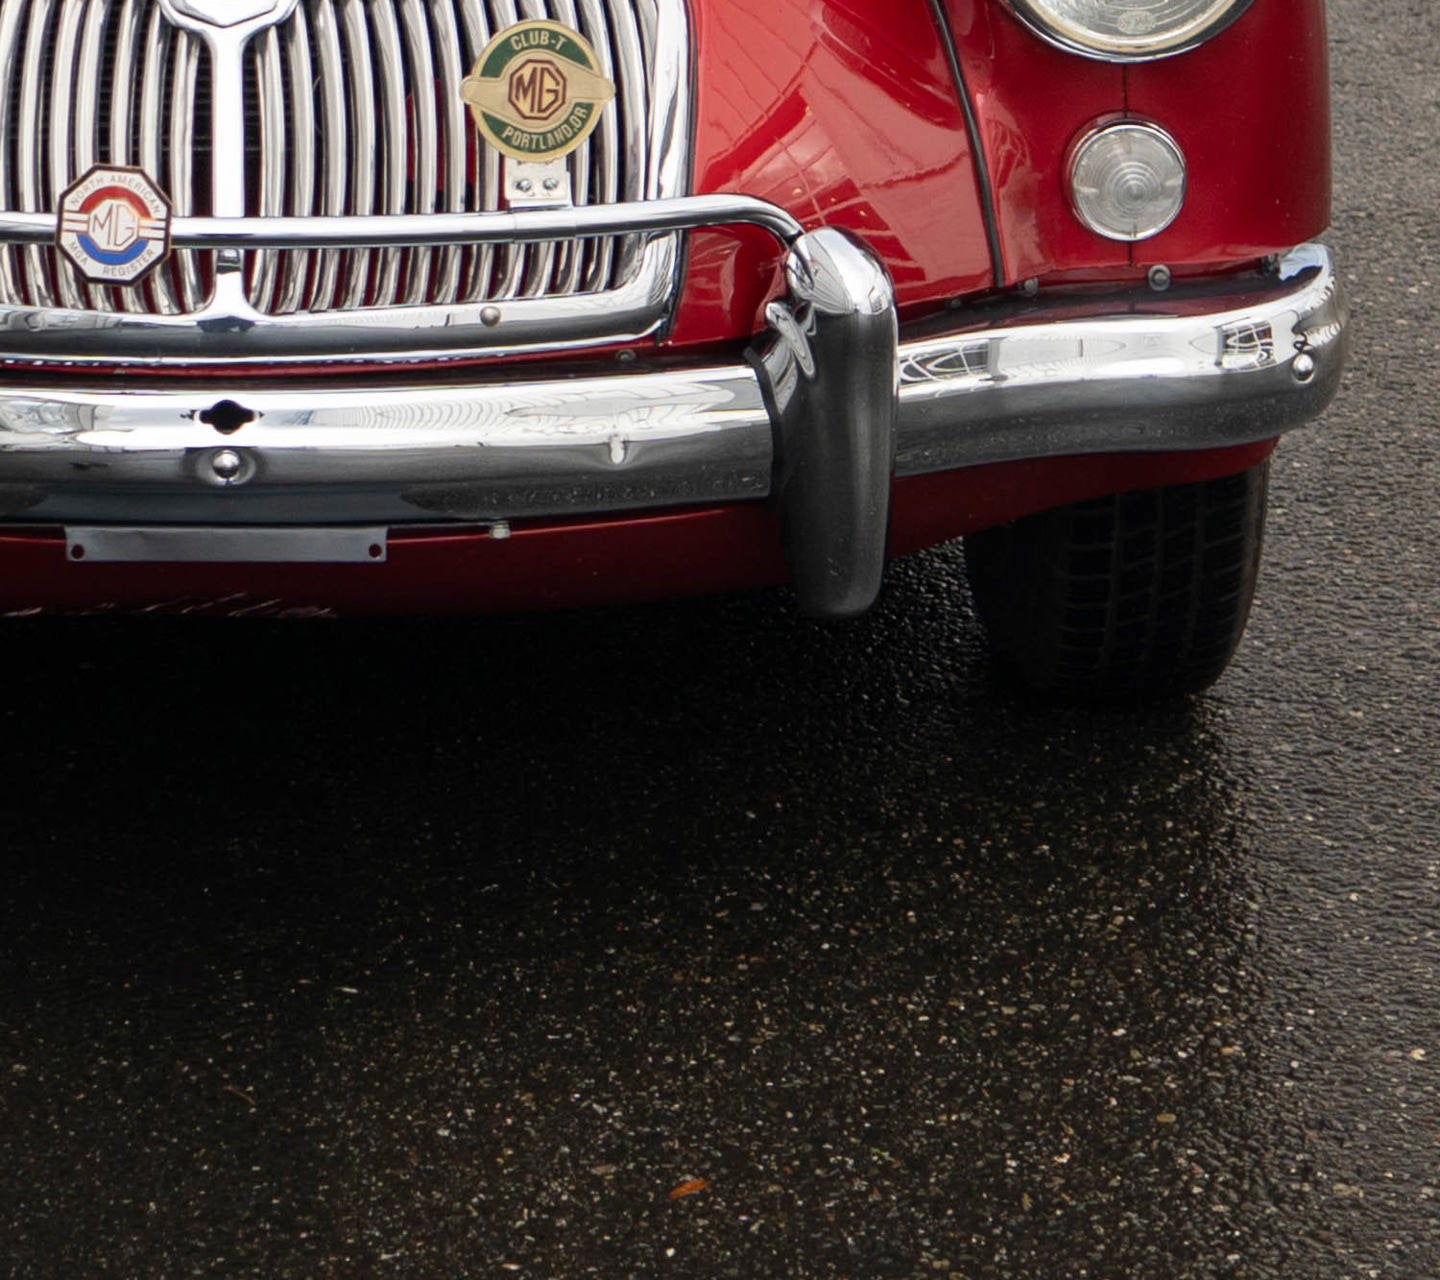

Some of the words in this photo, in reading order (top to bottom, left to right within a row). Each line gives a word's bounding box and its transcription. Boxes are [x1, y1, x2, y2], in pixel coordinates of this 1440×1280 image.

[510, 30, 568, 51] CLUB-T
[515, 66, 560, 113] MG
[71, 177, 104, 206] NORTH
[110, 175, 161, 214] AMERICAN
[93, 203, 135, 247] MG
[69, 241, 88, 266] MGA
[102, 248, 154, 277] REGISTER
